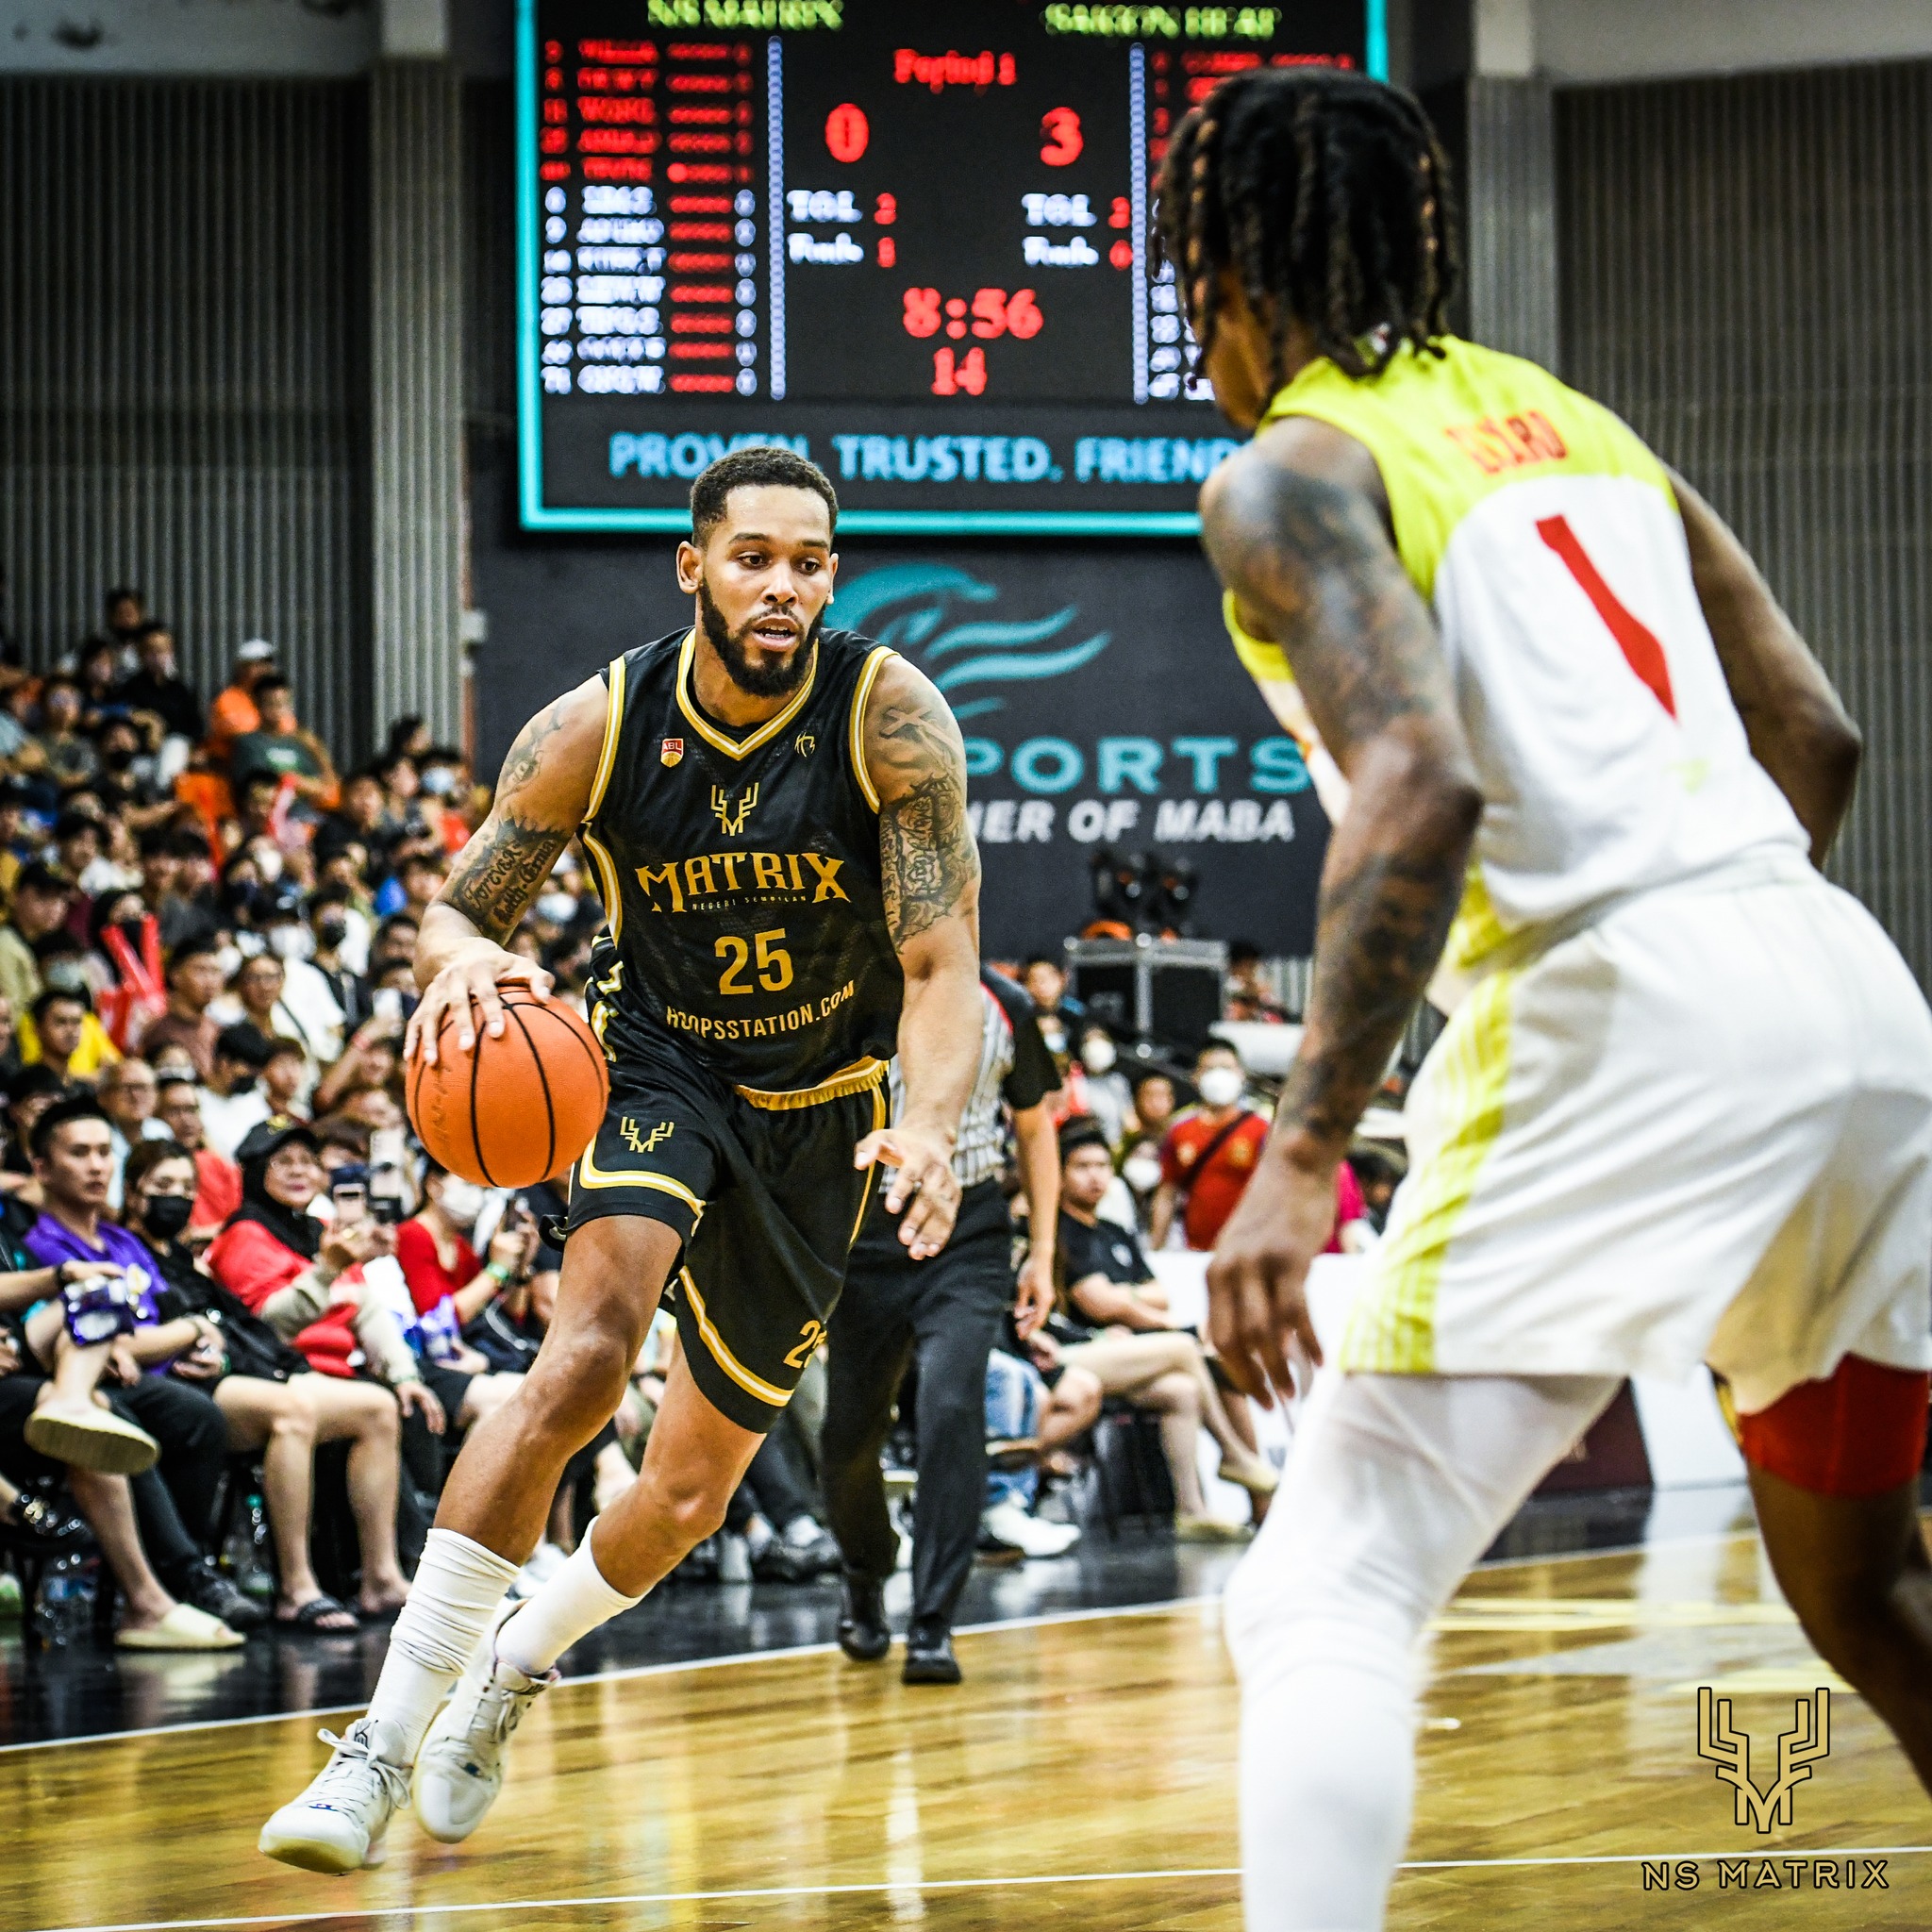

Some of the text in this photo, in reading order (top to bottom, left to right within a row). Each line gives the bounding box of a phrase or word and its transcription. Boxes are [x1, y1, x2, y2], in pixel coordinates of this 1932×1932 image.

[824, 103, 869, 163] 0
[1040, 107, 1084, 167] 3
[902, 287, 1044, 340] 8:56
[930, 346, 988, 396] 14
[831, 433, 1064, 484] TRUSTED.
[1535, 512, 1679, 726] 1
[663, 741, 682, 751] ABL
[1067, 799, 1141, 843] OF
[1153, 798, 1296, 843] MABA
[634, 851, 852, 914] MATRIX
[714, 927, 793, 995] 25
